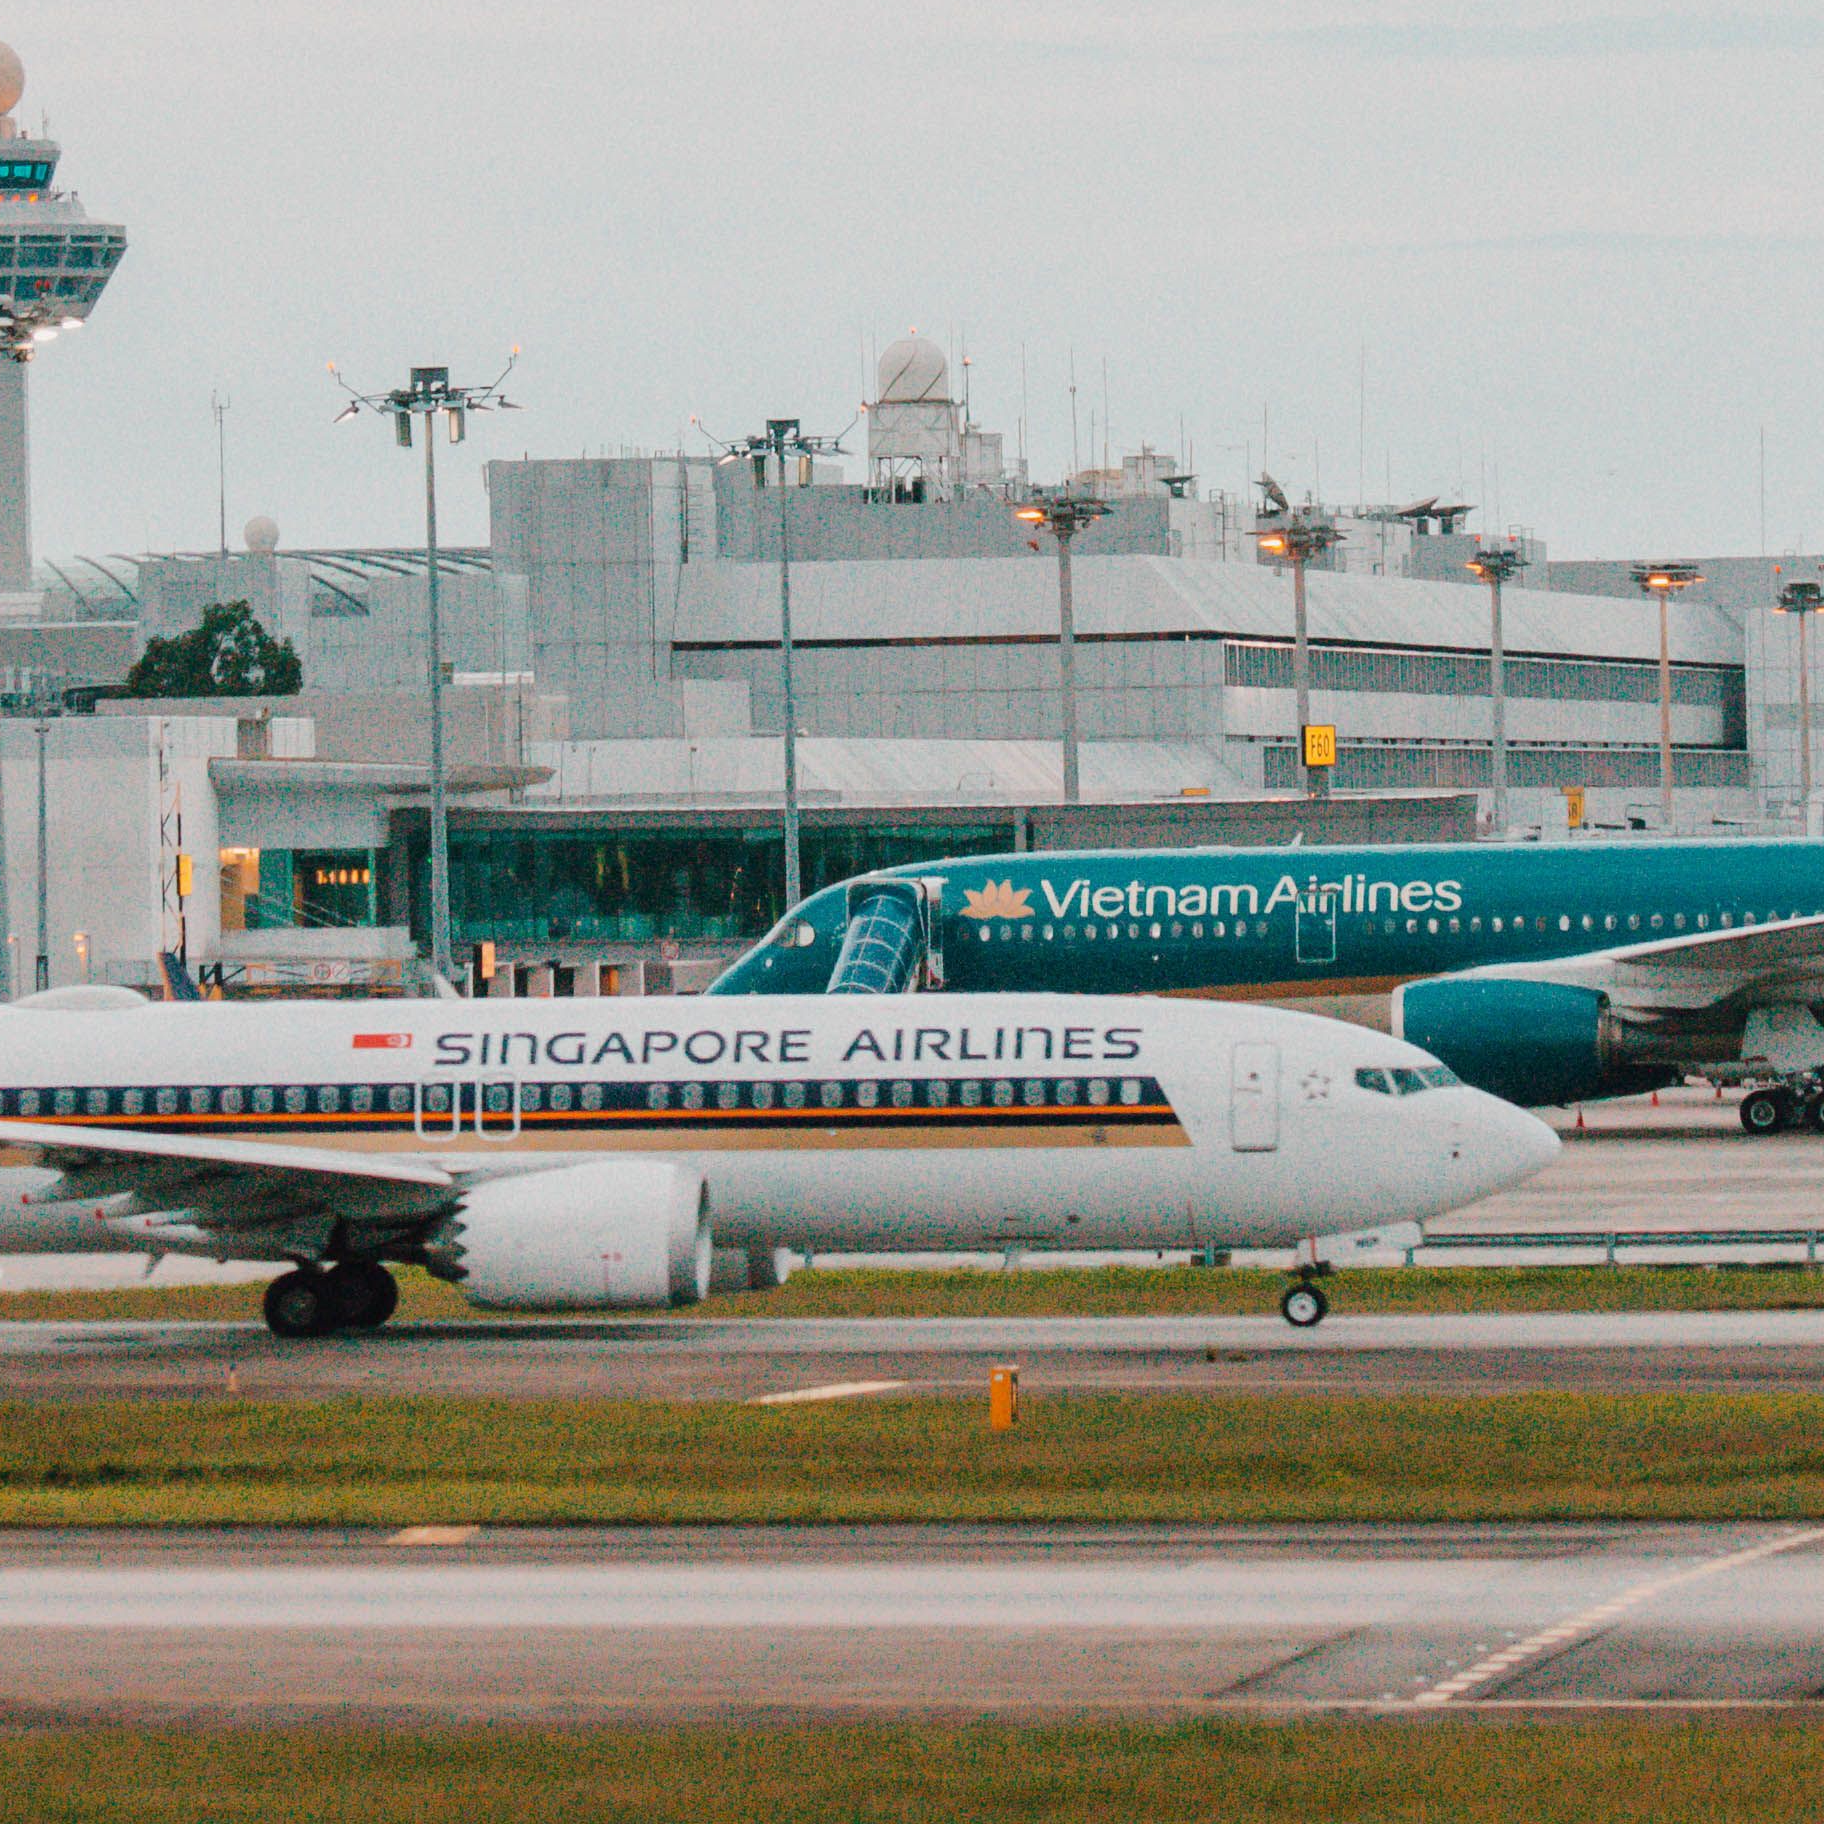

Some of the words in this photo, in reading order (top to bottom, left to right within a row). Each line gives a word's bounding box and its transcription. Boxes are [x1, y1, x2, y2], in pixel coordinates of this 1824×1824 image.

[1310, 733, 1330, 759] F60
[1040, 879, 1258, 918] Vietnam
[1264, 874, 1463, 914] Airlines
[434, 1029, 813, 1066] SINGAPORE
[842, 1027, 1142, 1063] AIRLINES
